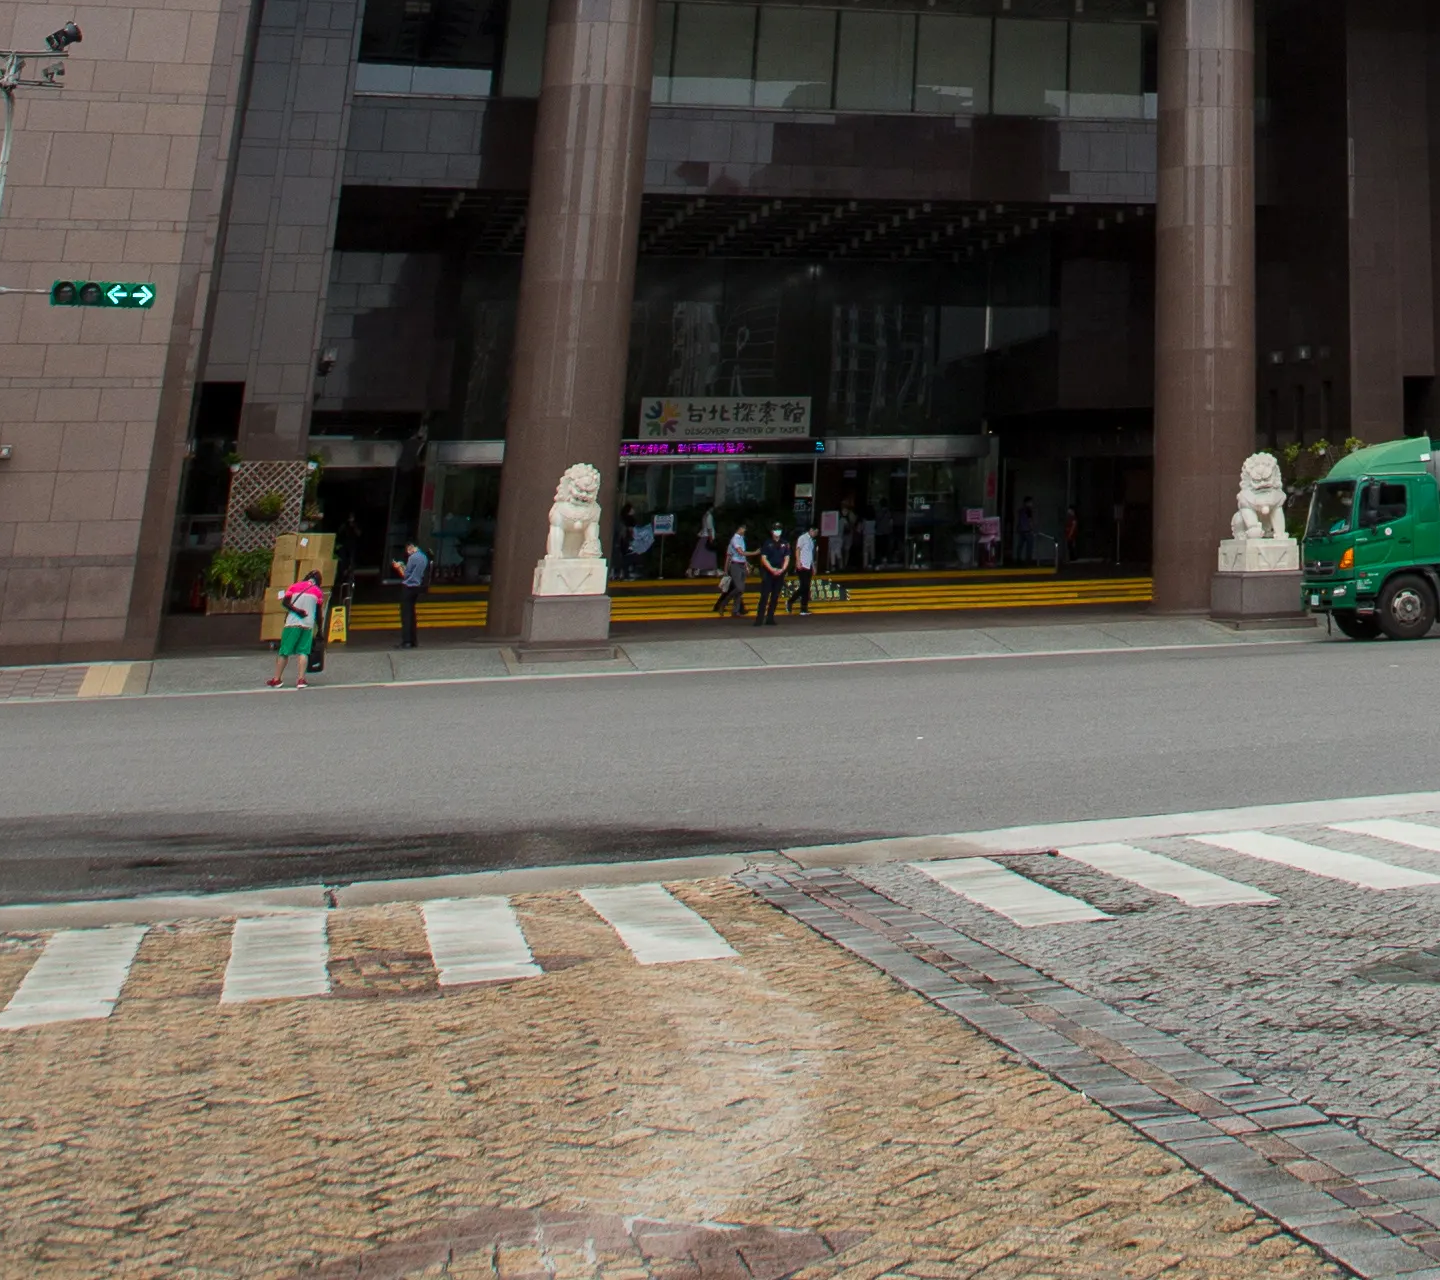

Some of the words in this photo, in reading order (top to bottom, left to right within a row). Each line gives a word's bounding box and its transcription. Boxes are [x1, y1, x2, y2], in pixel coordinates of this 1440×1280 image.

[686, 400, 806, 425] 台北探索館
